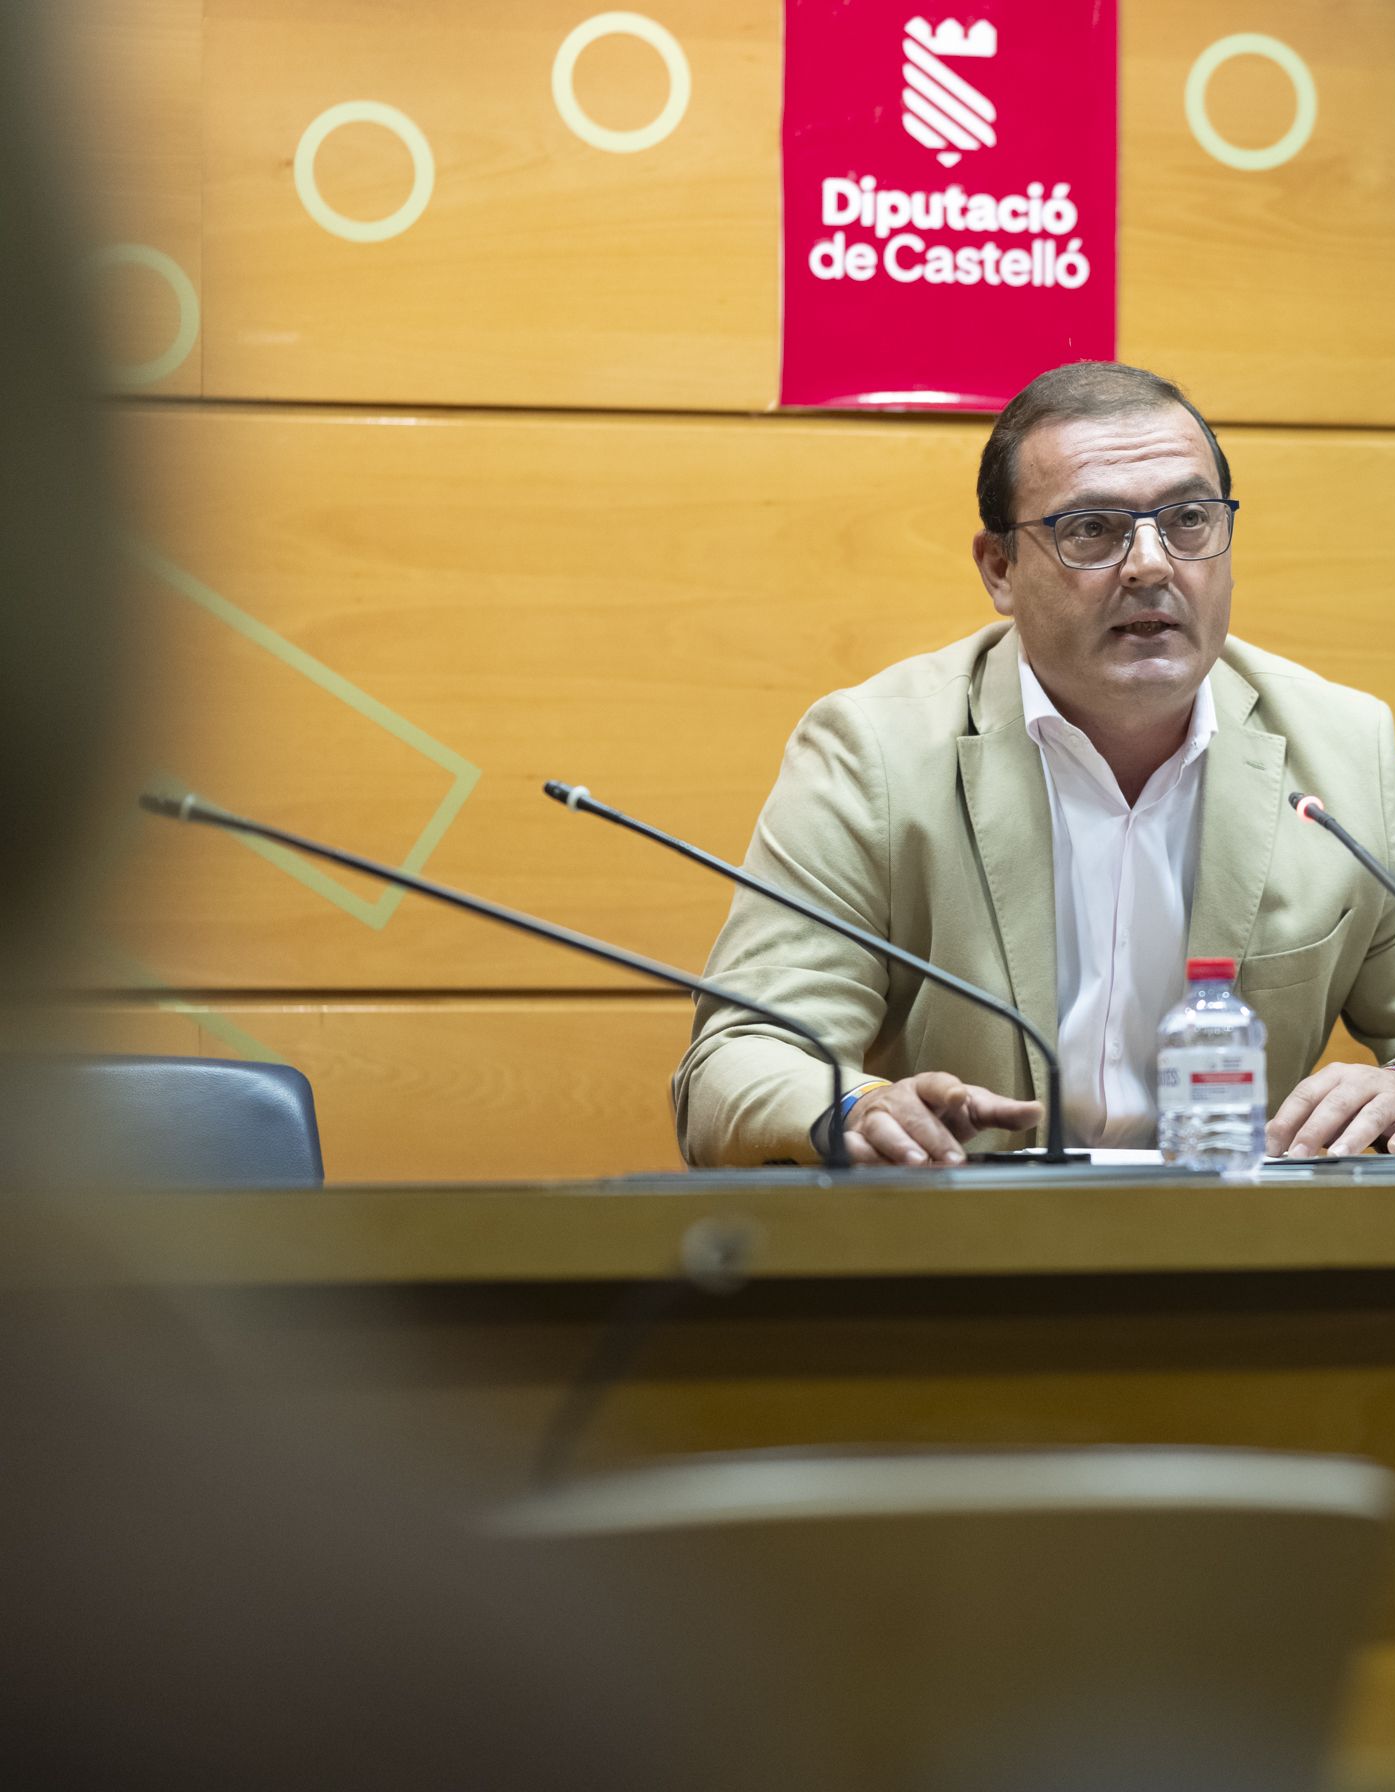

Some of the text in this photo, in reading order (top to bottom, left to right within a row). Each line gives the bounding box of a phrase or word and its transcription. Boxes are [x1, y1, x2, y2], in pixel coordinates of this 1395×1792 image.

[821, 175, 1078, 239] Diputació
[808, 231, 1091, 289] de Castelló
